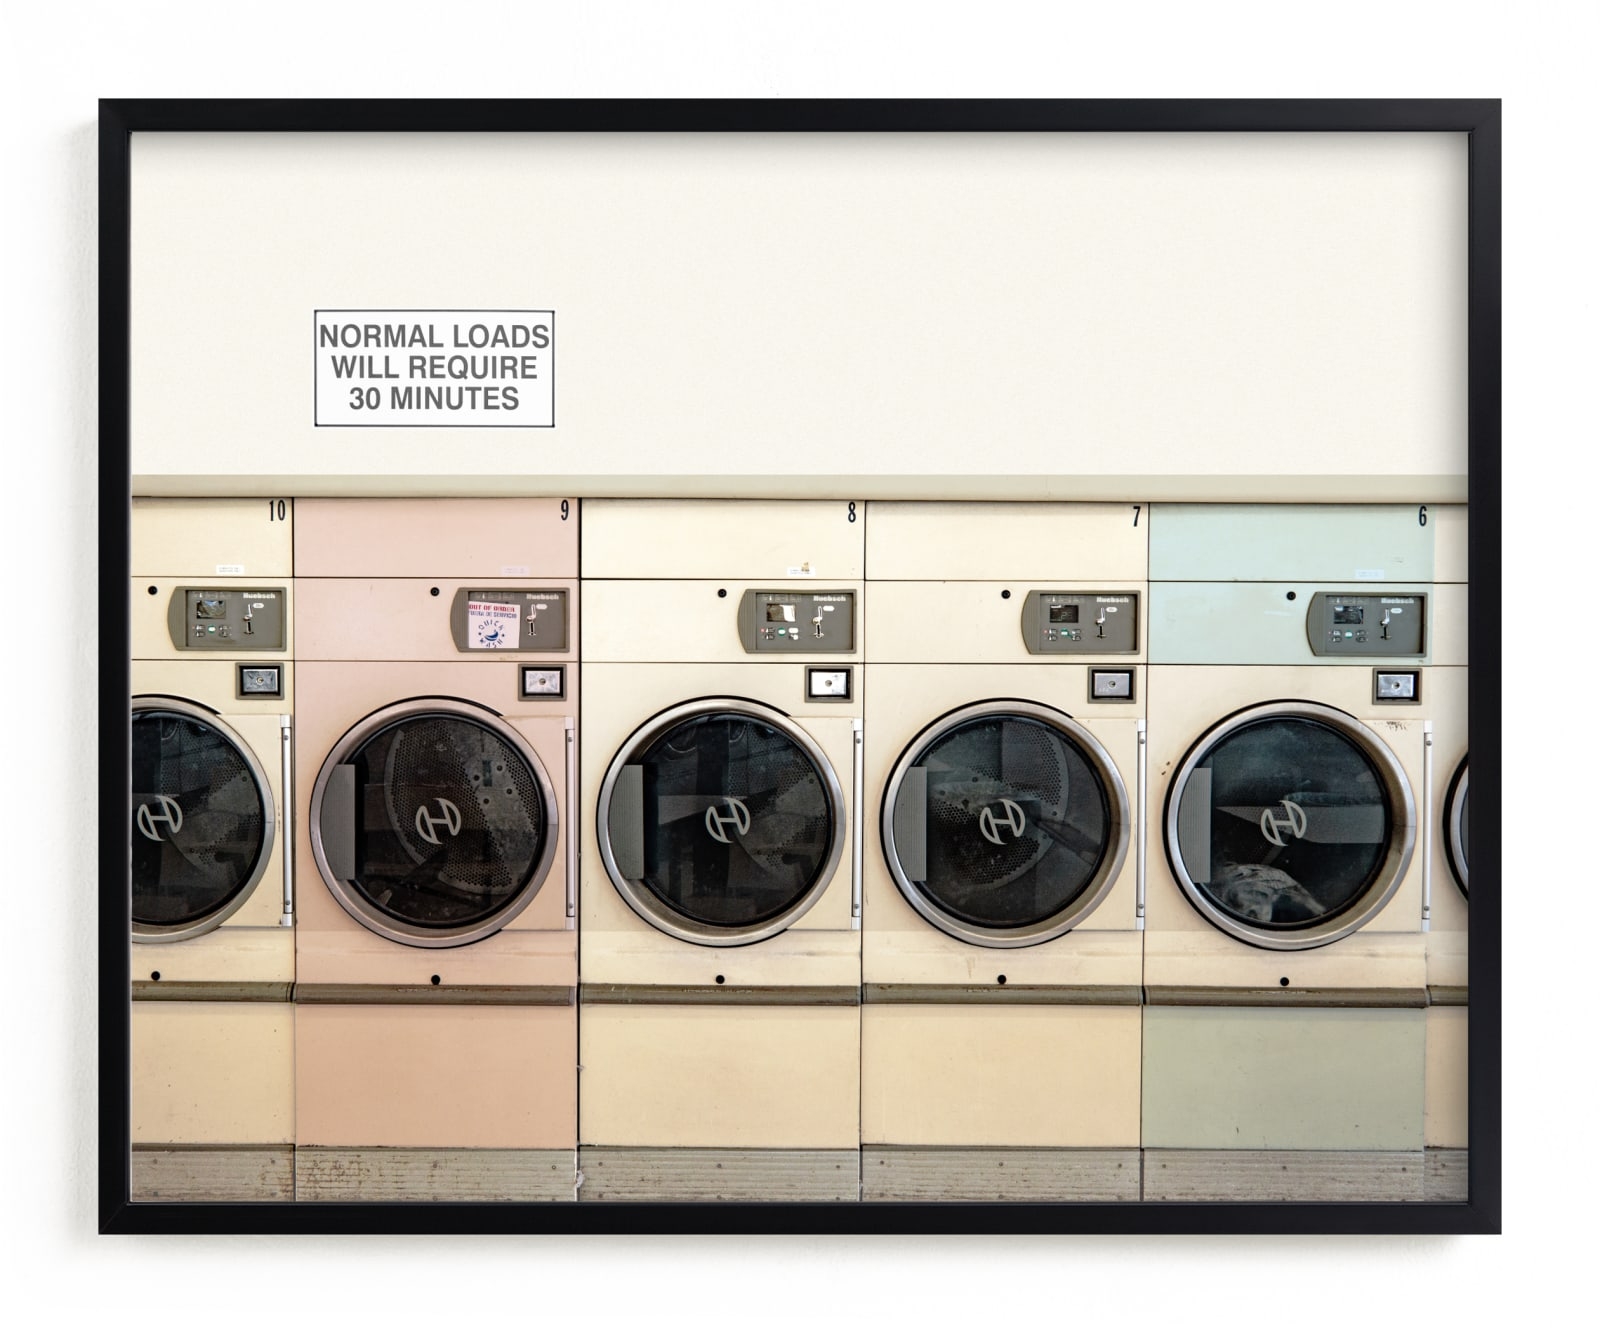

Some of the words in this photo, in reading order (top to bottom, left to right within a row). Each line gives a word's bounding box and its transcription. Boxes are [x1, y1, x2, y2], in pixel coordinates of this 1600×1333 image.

[320, 324, 444, 348] NORMAL
[453, 324, 550, 349] LOADS
[331, 355, 399, 379] WILL
[409, 355, 538, 380] REQUIRE
[349, 387, 381, 410] 30
[391, 386, 519, 411] MINUTES
[269, 499, 286, 522] 10
[560, 499, 569, 521] 9
[848, 501, 856, 523] 8
[1133, 505, 1141, 527] 7
[1418, 505, 1427, 527] 6
